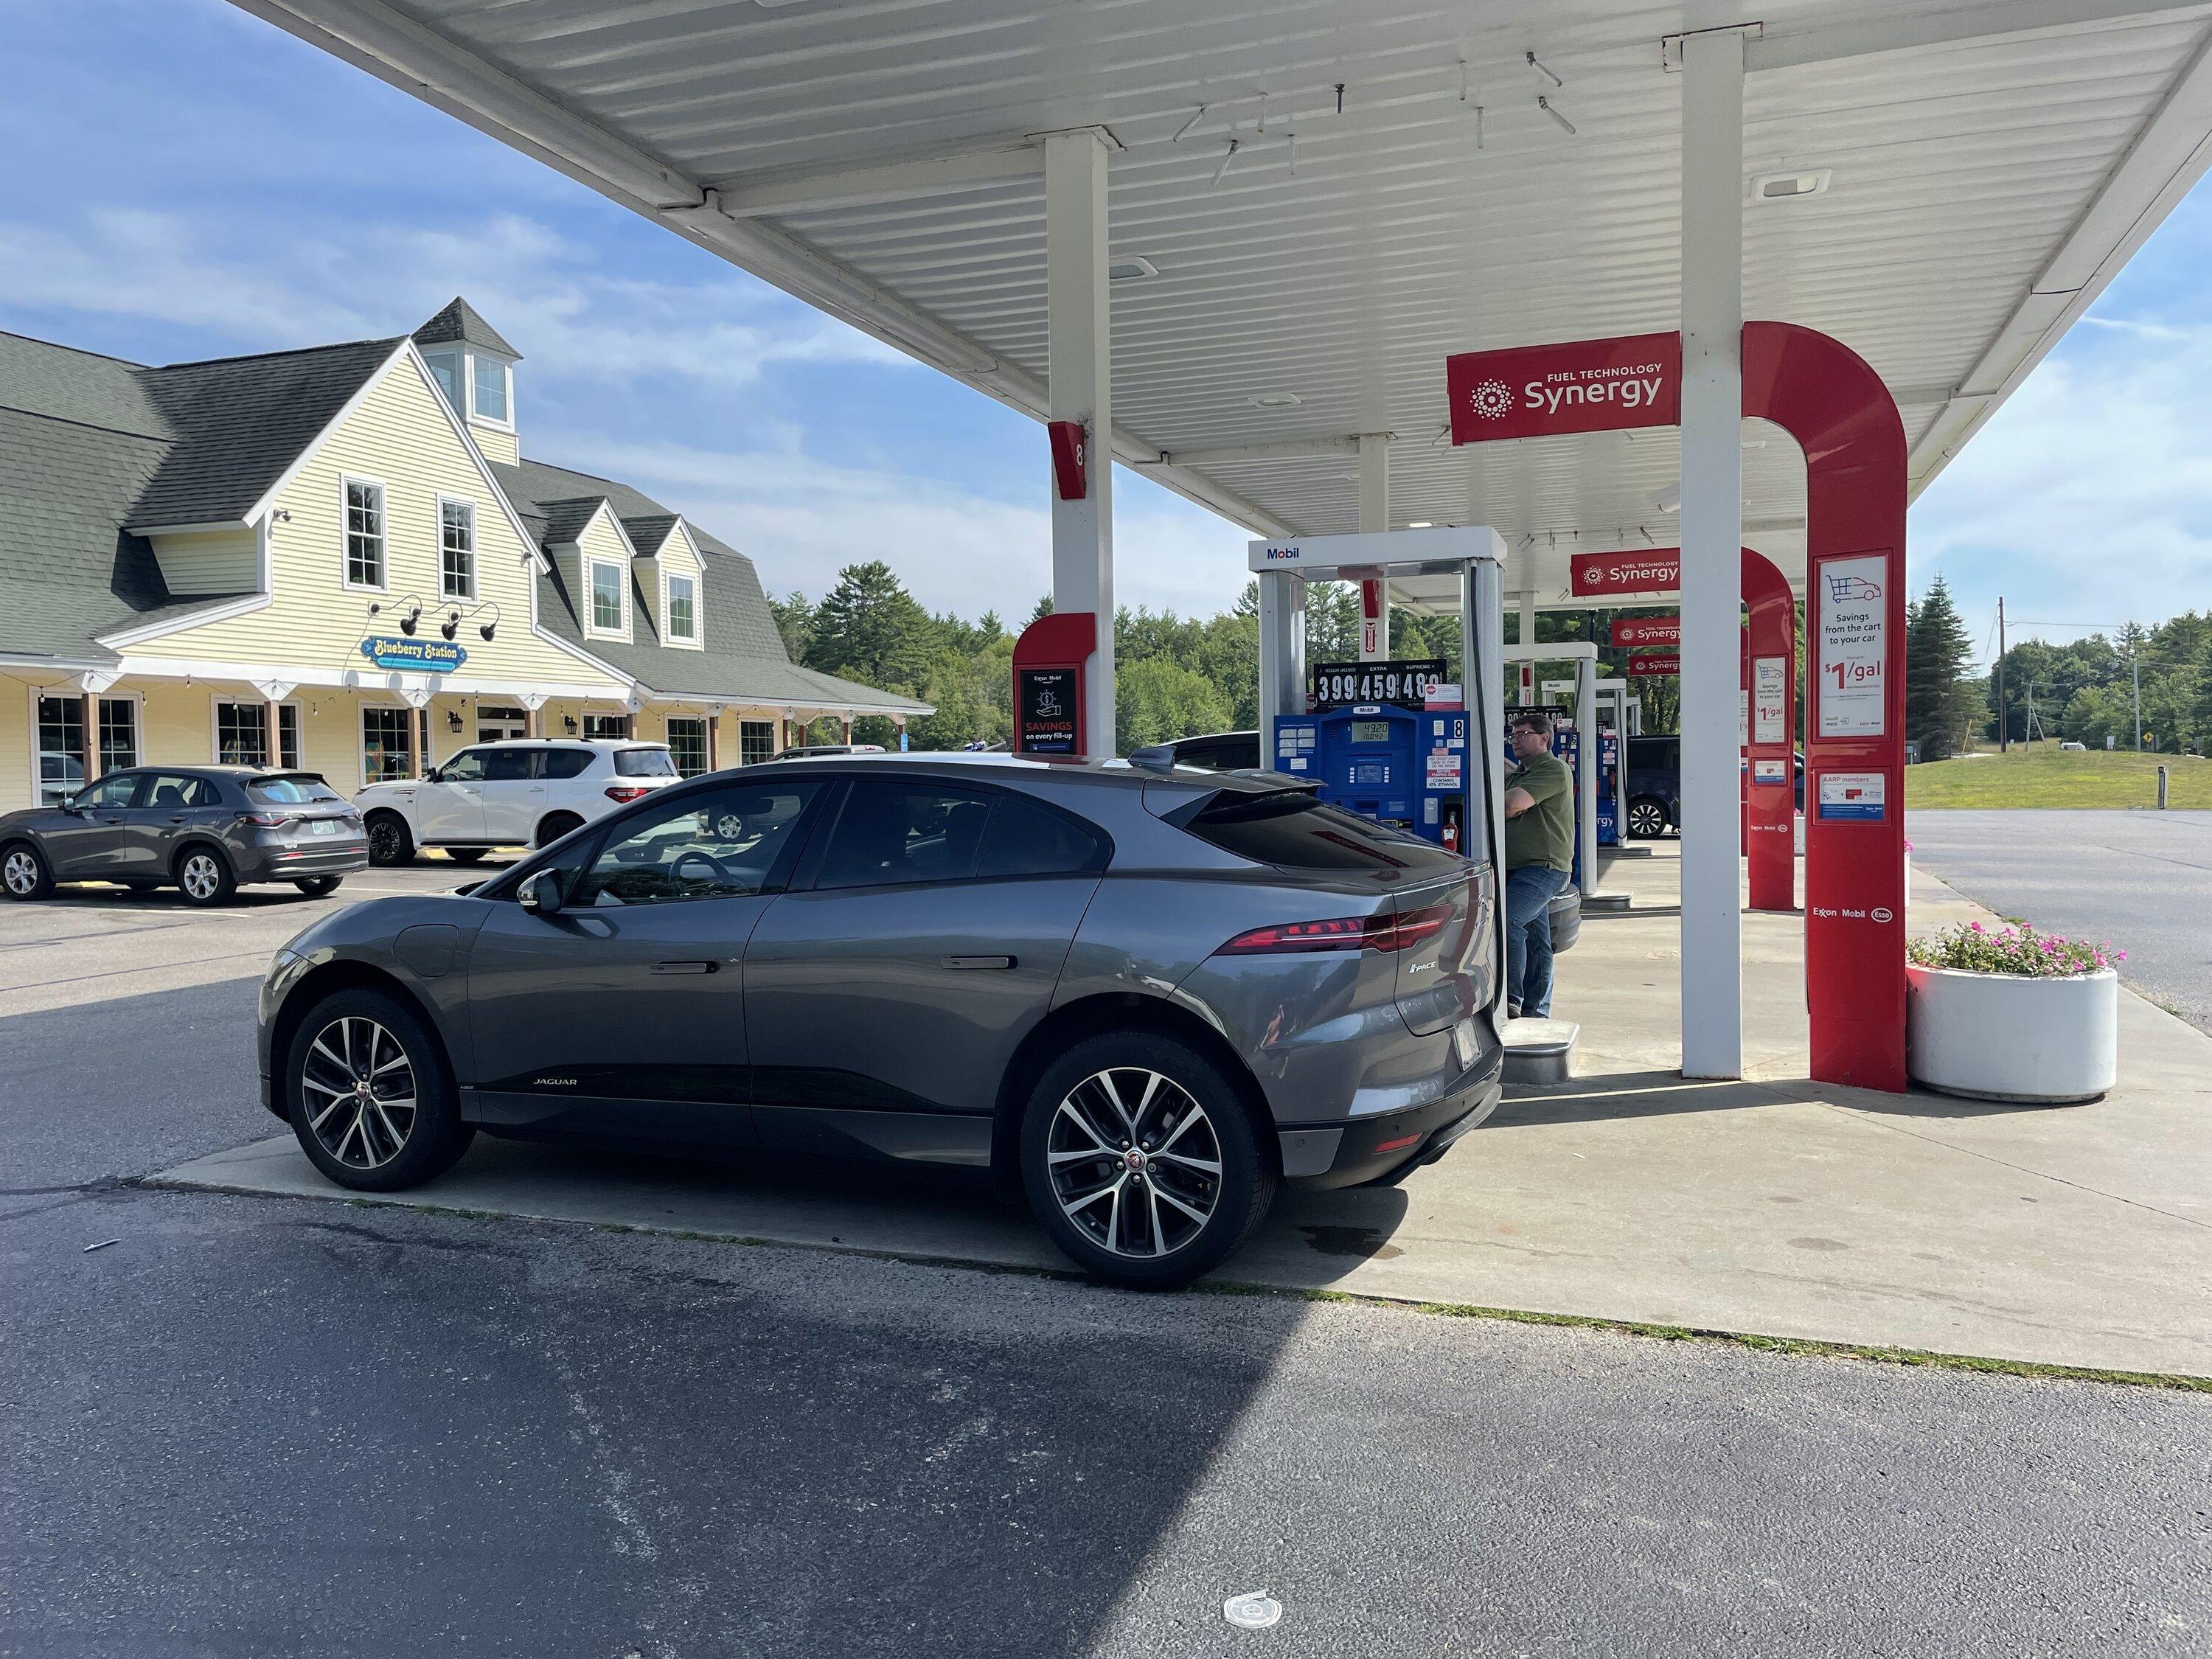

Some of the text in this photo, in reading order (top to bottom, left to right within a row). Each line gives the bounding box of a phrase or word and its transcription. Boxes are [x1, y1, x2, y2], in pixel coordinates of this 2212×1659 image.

[1548, 363, 1663, 382] FUEL TECHNOLOGY
[1524, 378, 1663, 414] Synergy
[1077, 443, 1082, 466] 8
[1267, 547, 1299, 559] Mobil
[1610, 567, 1679, 583] Synergy
[1836, 613, 1869, 622] Savings
[1847, 624, 1861, 632] the
[1840, 637, 1860, 646] your
[375, 639, 457, 659] Blueberry Station
[1026, 722, 1072, 731] SAVINGS
[1455, 720, 1462, 737] 8
[1813, 907, 1890, 919] Exxon Mobil Esso
